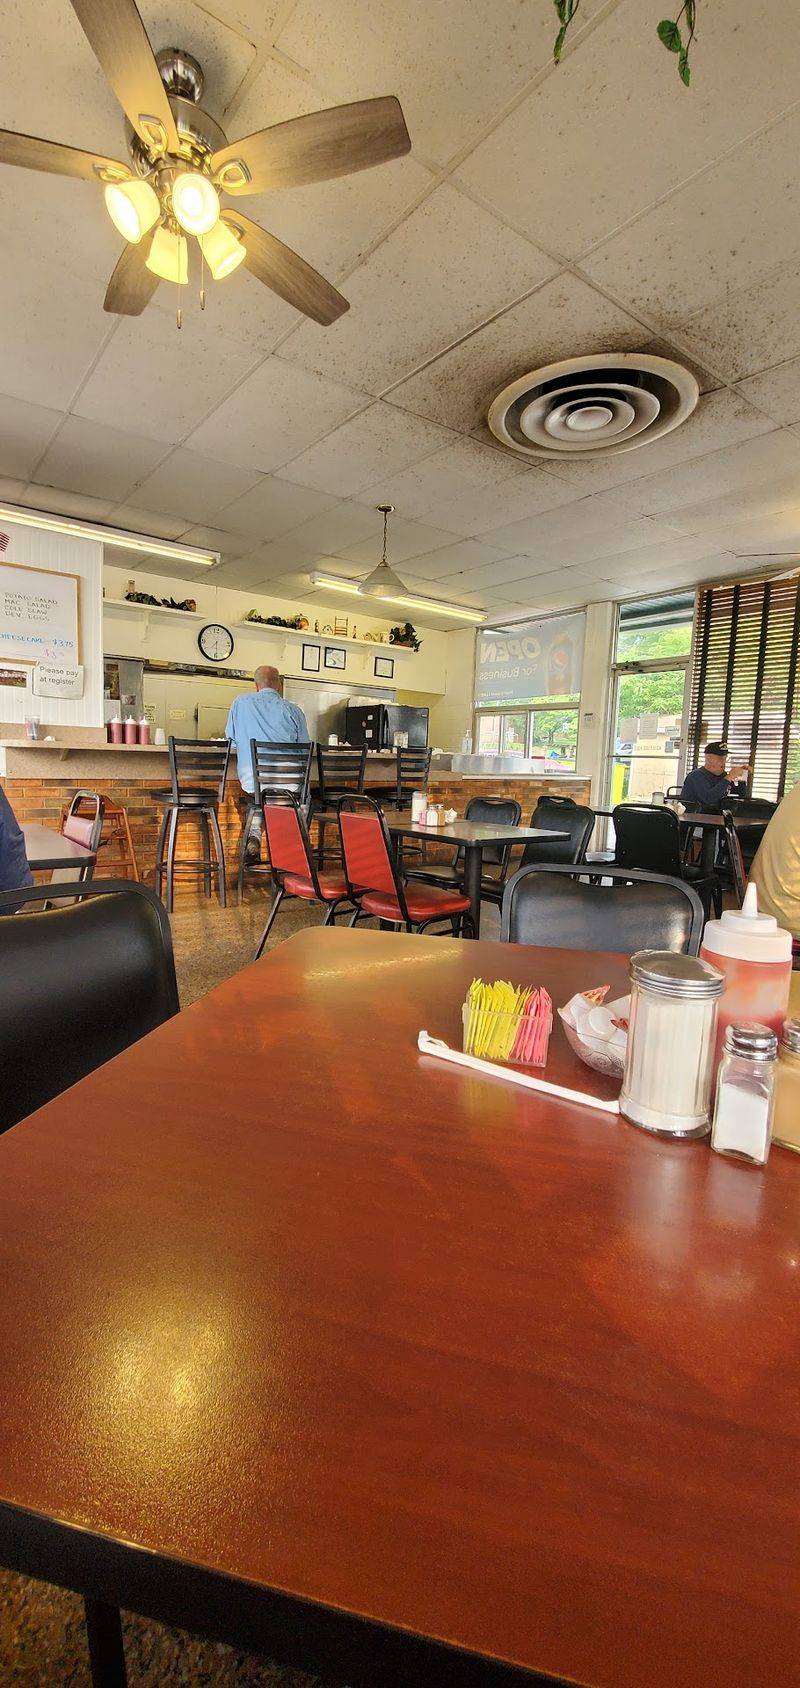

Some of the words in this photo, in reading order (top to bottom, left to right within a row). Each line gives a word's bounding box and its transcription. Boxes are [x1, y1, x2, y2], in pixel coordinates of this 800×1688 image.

[39, 665, 65, 675] Please
[66, 669, 79, 678] pay
[48, 677, 76, 686] register
